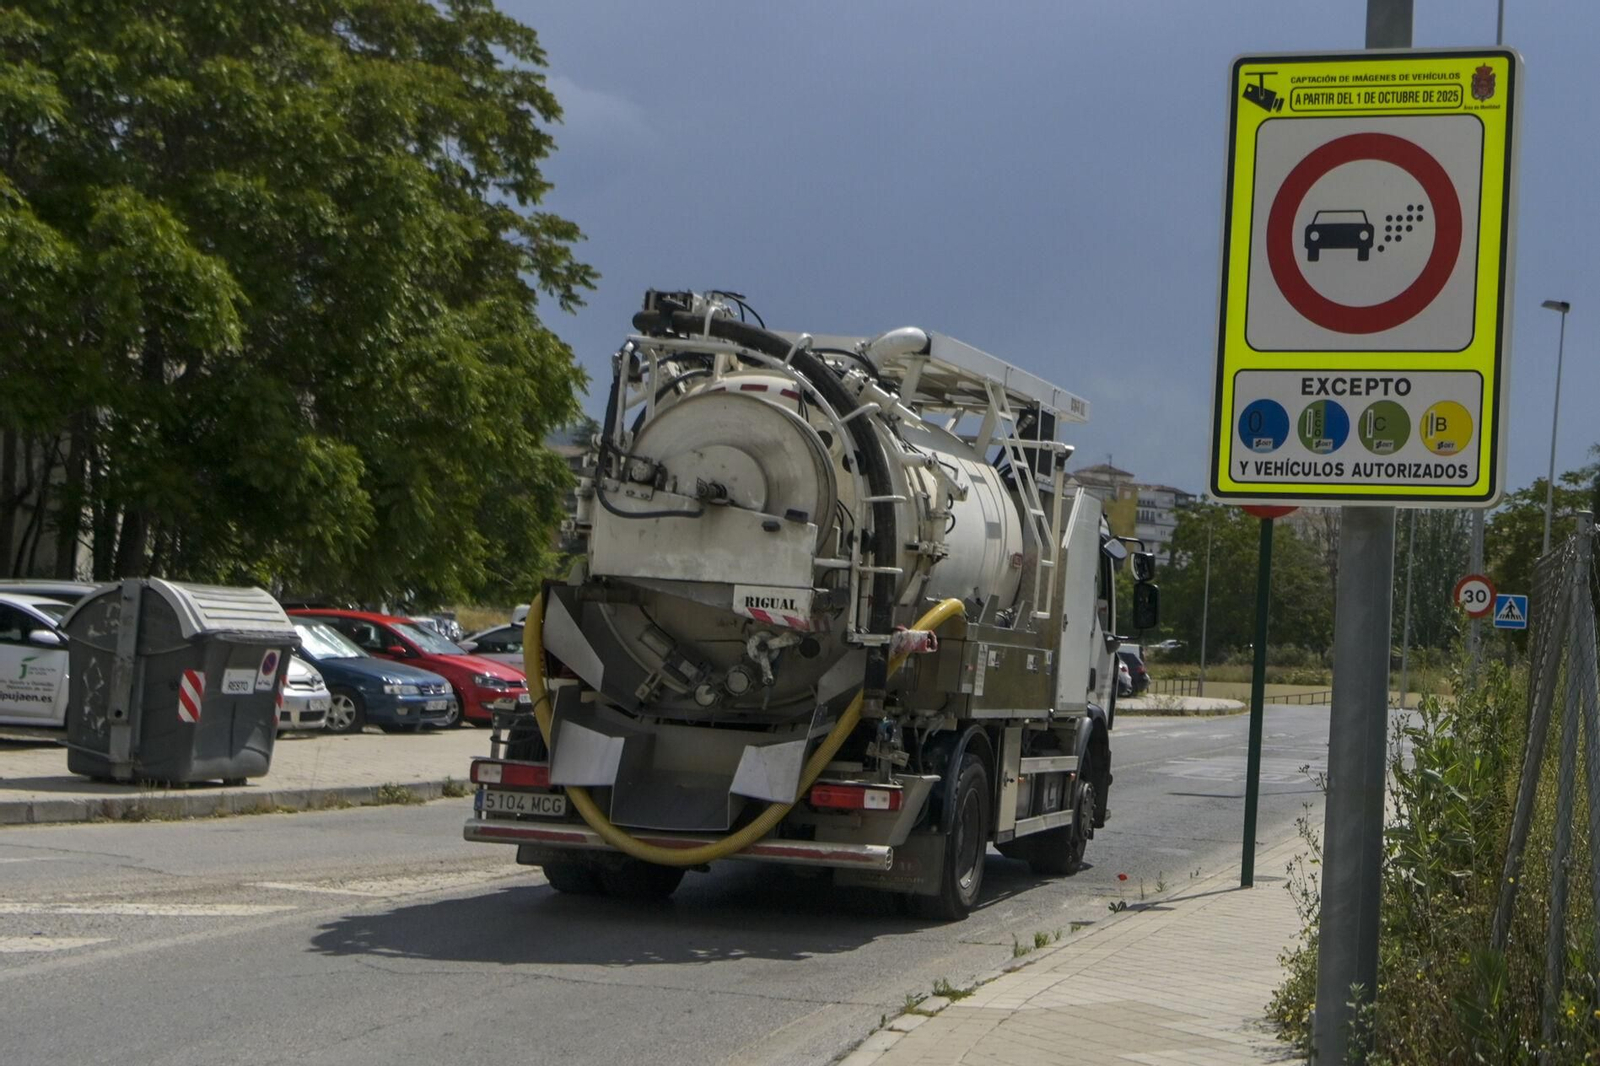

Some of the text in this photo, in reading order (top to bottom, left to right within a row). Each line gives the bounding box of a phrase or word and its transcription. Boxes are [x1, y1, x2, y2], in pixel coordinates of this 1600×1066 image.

[1290, 72, 1461, 84] CAPTACIÓN DE IMÁGENES DE VEHÍCULOS
[1295, 89, 1459, 105] A PARTIR DEL 1 DE OCTUBRE DE 2025
[1301, 377, 1412, 397] EXCEPTO
[1374, 416, 1387, 431] C
[1435, 417, 1447, 432] B
[1239, 458, 1469, 479] Y VEHÍCULOS AUTORIZADOS
[745, 596, 798, 611] RIGUAL
[1464, 589, 1487, 603] 30
[486, 793, 562, 813] 5104 MCG
